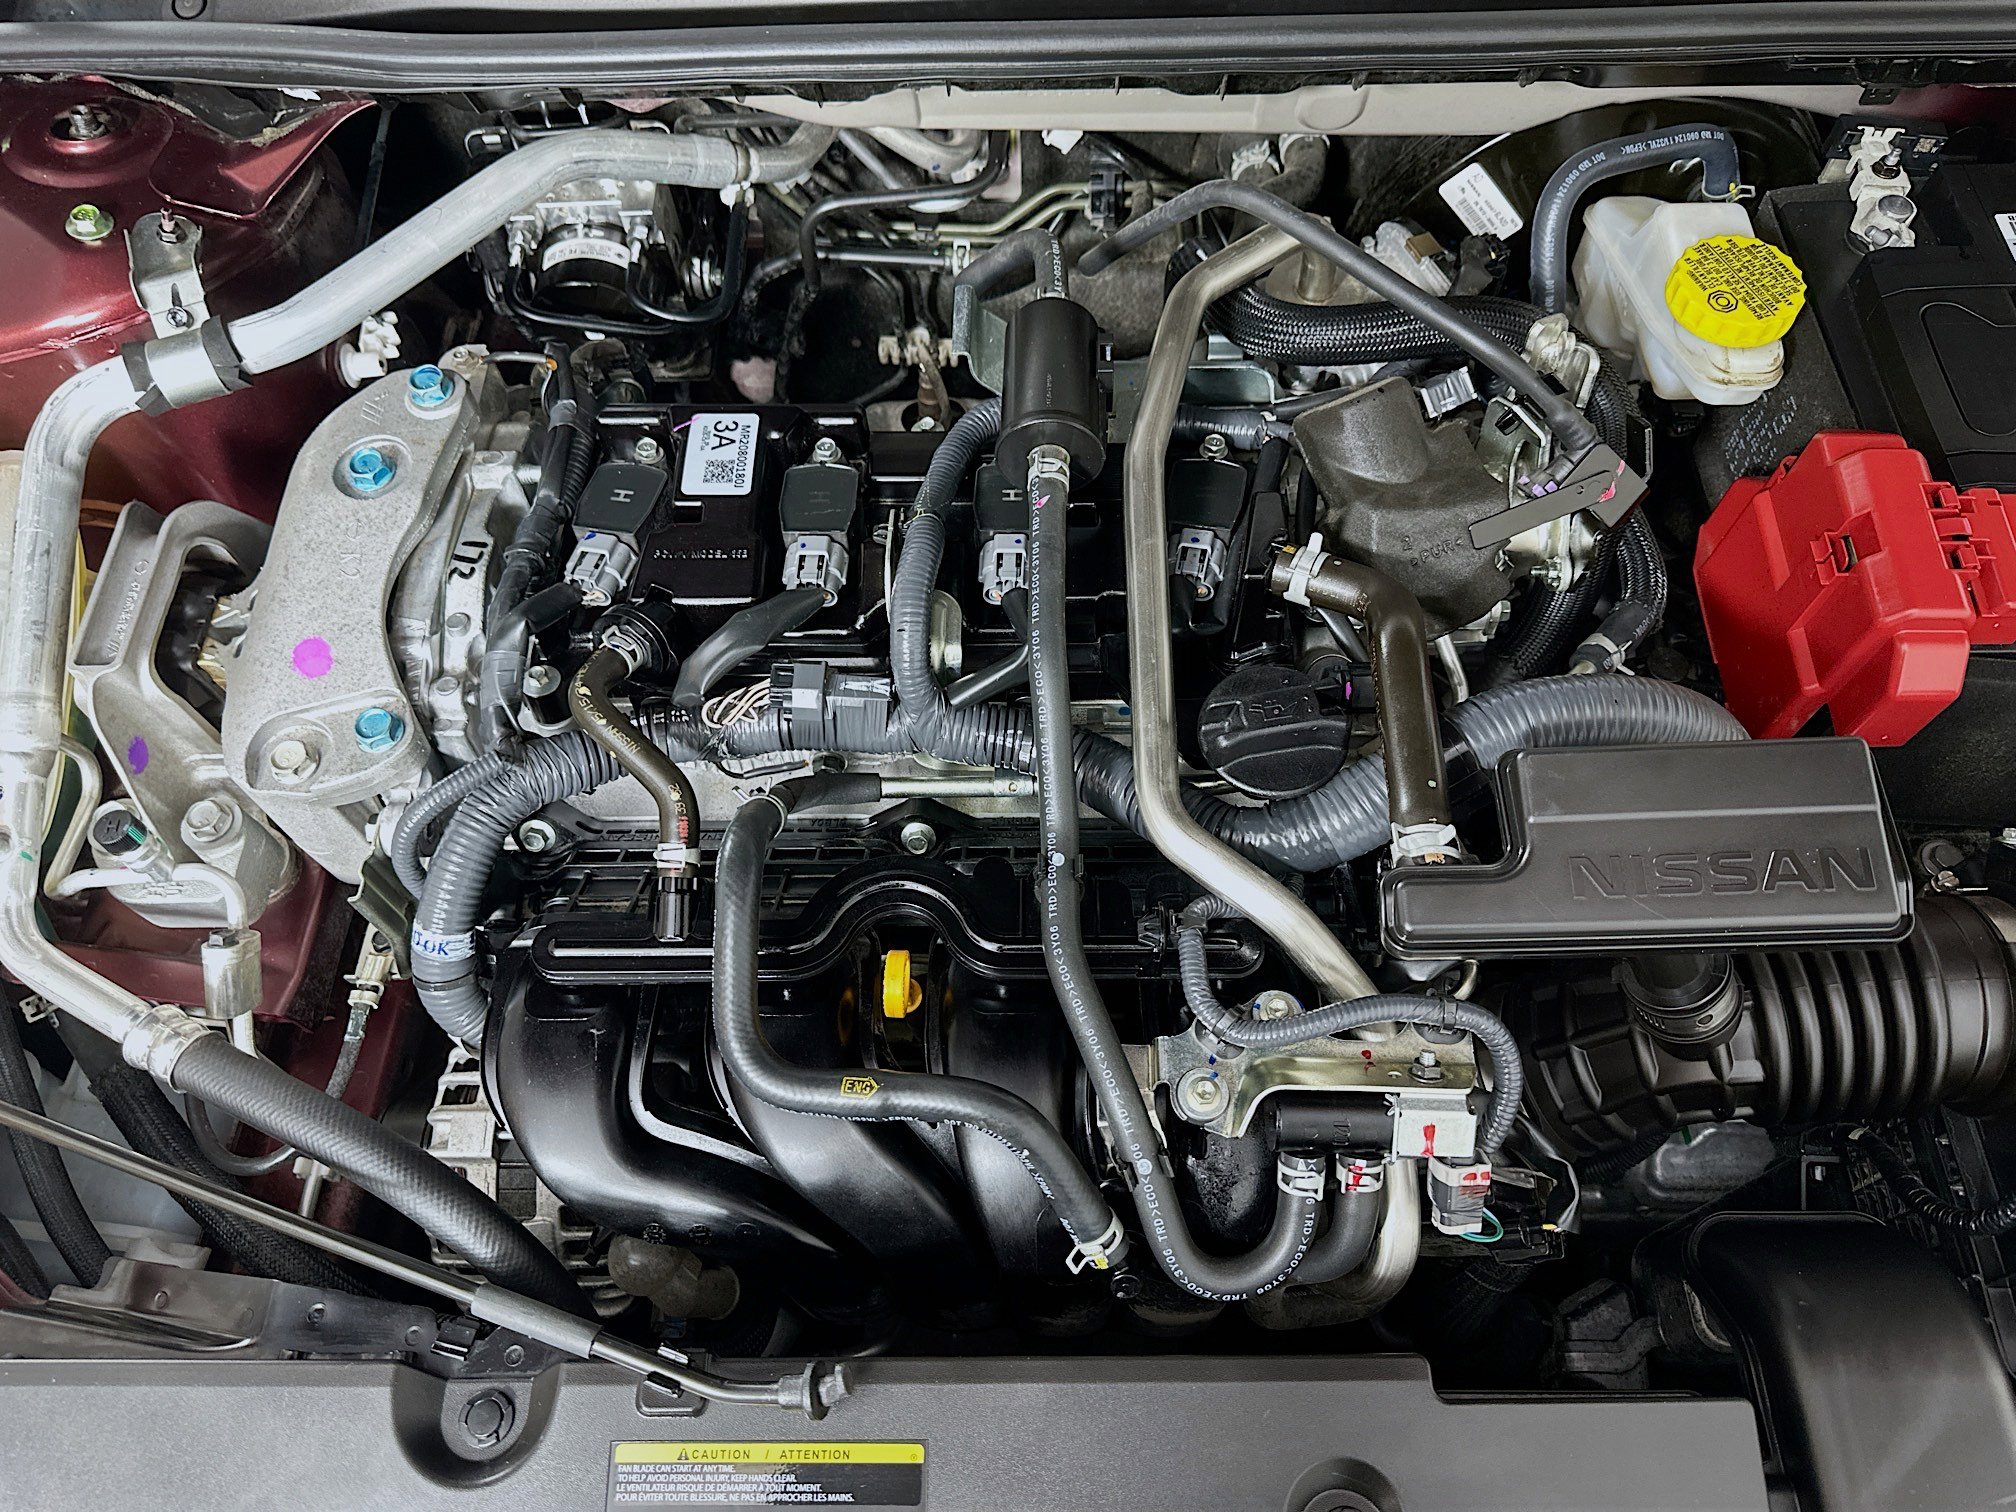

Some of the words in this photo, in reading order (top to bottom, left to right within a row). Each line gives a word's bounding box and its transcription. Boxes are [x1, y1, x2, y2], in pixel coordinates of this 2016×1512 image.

[1050, 238, 1062, 292] TRD>ECO<3Y
[711, 420, 739, 451] 3A
[1031, 541, 1041, 624] TRD>ECO<3Y06
[1032, 629, 1049, 730] TRD>ECO<3Y06
[1040, 737, 1057, 827] TRD>ECO<3Y06
[1567, 848, 1877, 900] NISSAN
[1049, 925, 1088, 1023] TRD>ECO<3Y06
[845, 1080, 871, 1094] ENG
[1085, 1028, 1134, 1137] TRD>ECO<3Y06
[1163, 1248, 1249, 1301] TRD>ECO<3Y06
[1256, 1212, 1315, 1295] TRD>ECO<3Y06
[618, 1464, 632, 1473] FAN
[633, 1464, 656, 1473] BLADE
[656, 1464, 671, 1473] CAN
[671, 1464, 693, 1473] START
[693, 1464, 701, 1473] AT
[618, 1474, 629, 1483] TO
[629, 1474, 646, 1483] HELP
[646, 1474, 669, 1483] AVOID
[669, 1474, 705, 1483] PERSONAL
[731, 1474, 748, 1483] KEEP
[749, 1474, 773, 1483] HANDS
[773, 1474, 797, 1483] CLEAR.
[692, 1449, 751, 1460] CAUTION
[779, 1449, 851, 1460] ATTENTION
[616, 1493, 637, 1502] POUR
[638, 1493, 664, 1502] ÉVITER
[664, 1493, 688, 1502] TOUTE
[729, 1493, 740, 1502] NE
[741, 1493, 755, 1502] PAS
[756, 1493, 766, 1502] EN
[768, 1493, 813, 1502] APPROCHER
[814, 1493, 827, 1502] LES
[828, 1493, 855, 1502] MAINS.
[617, 1483, 626, 1492] LE
[626, 1483, 676, 1492] VENTILATEUR
[676, 1483, 704, 1492] RISQUE
[705, 1483, 715, 1492] DE
[717, 1483, 757, 1492] DÉMARRER
[765, 1483, 785, 1492] TOUT
[786, 1483, 822, 1492] MOMENT.
